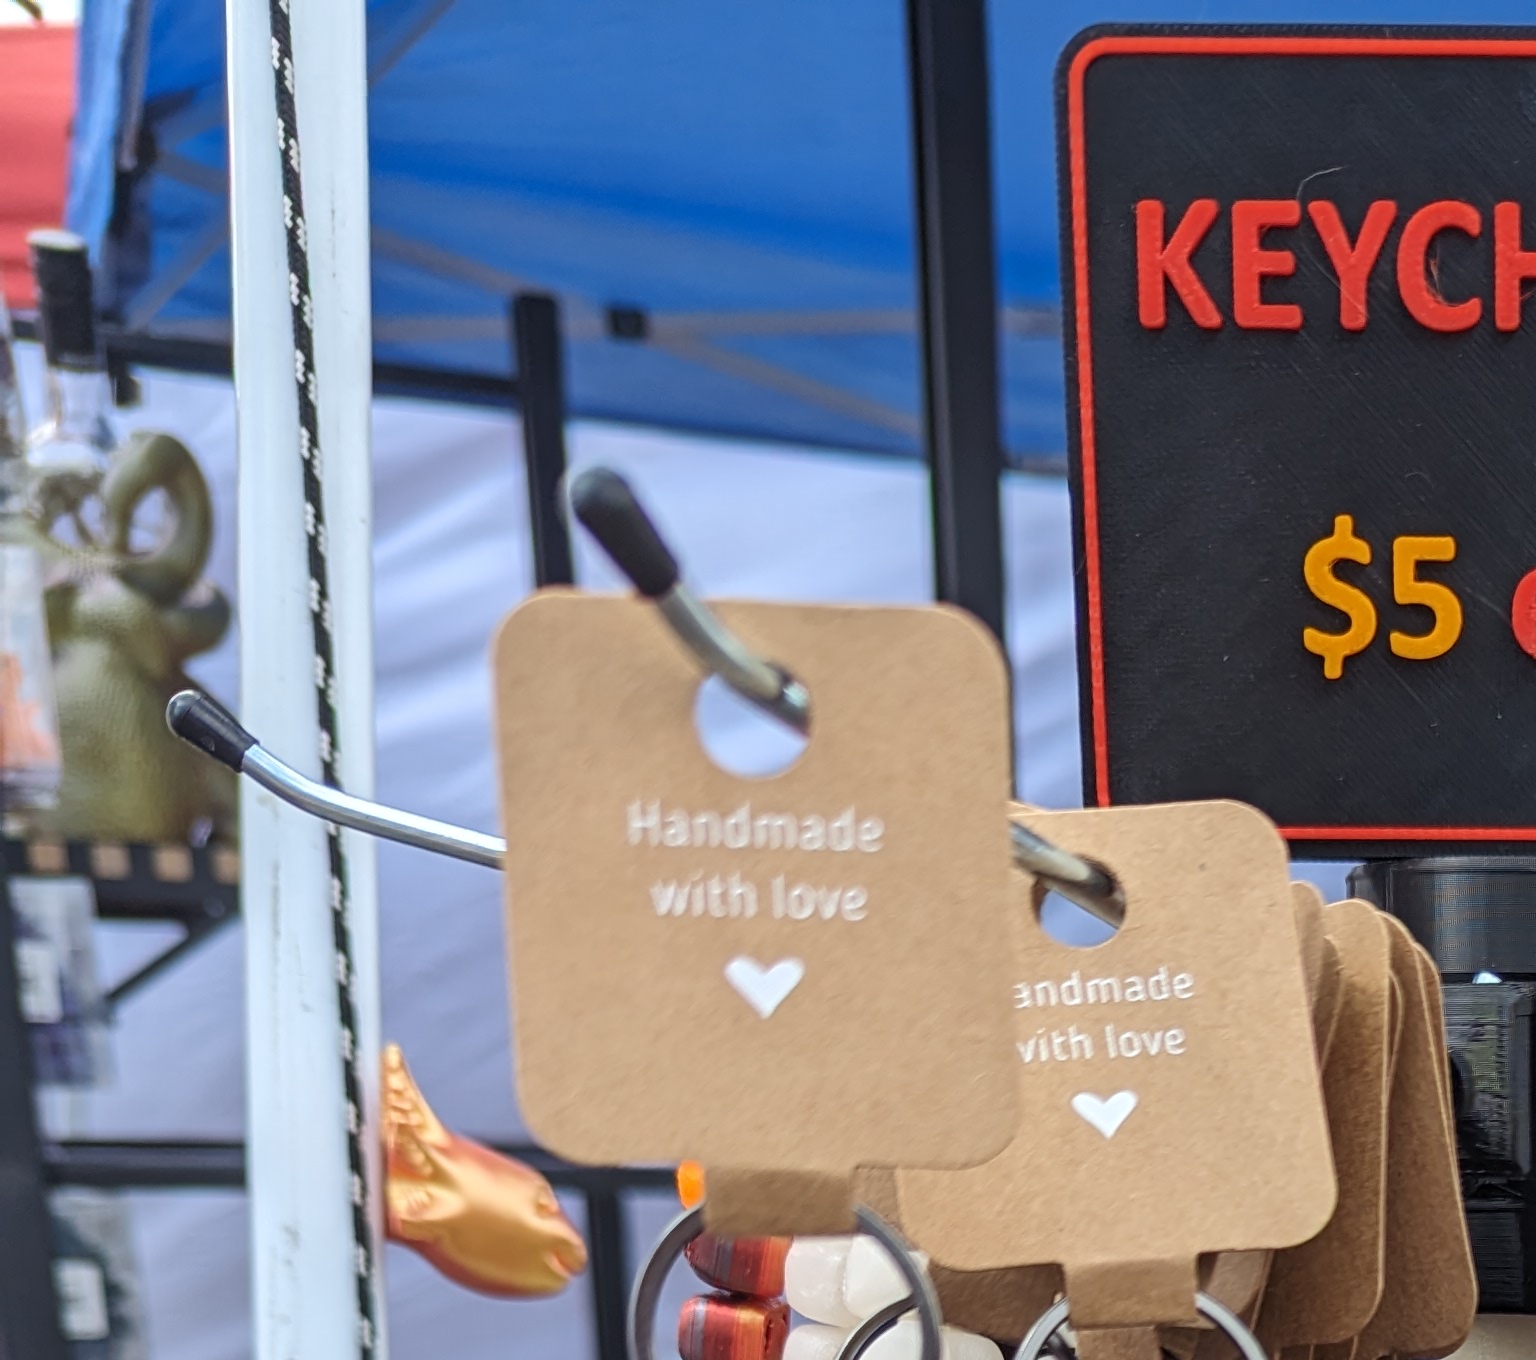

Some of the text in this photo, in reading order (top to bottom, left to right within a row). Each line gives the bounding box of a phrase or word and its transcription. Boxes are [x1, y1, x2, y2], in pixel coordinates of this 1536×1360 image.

[1302, 514, 1463, 680] $5
[626, 797, 885, 853] Handmade
[650, 868, 869, 922] with love
[1012, 965, 1195, 1009] andmade
[1104, 1023, 1187, 1059] love
